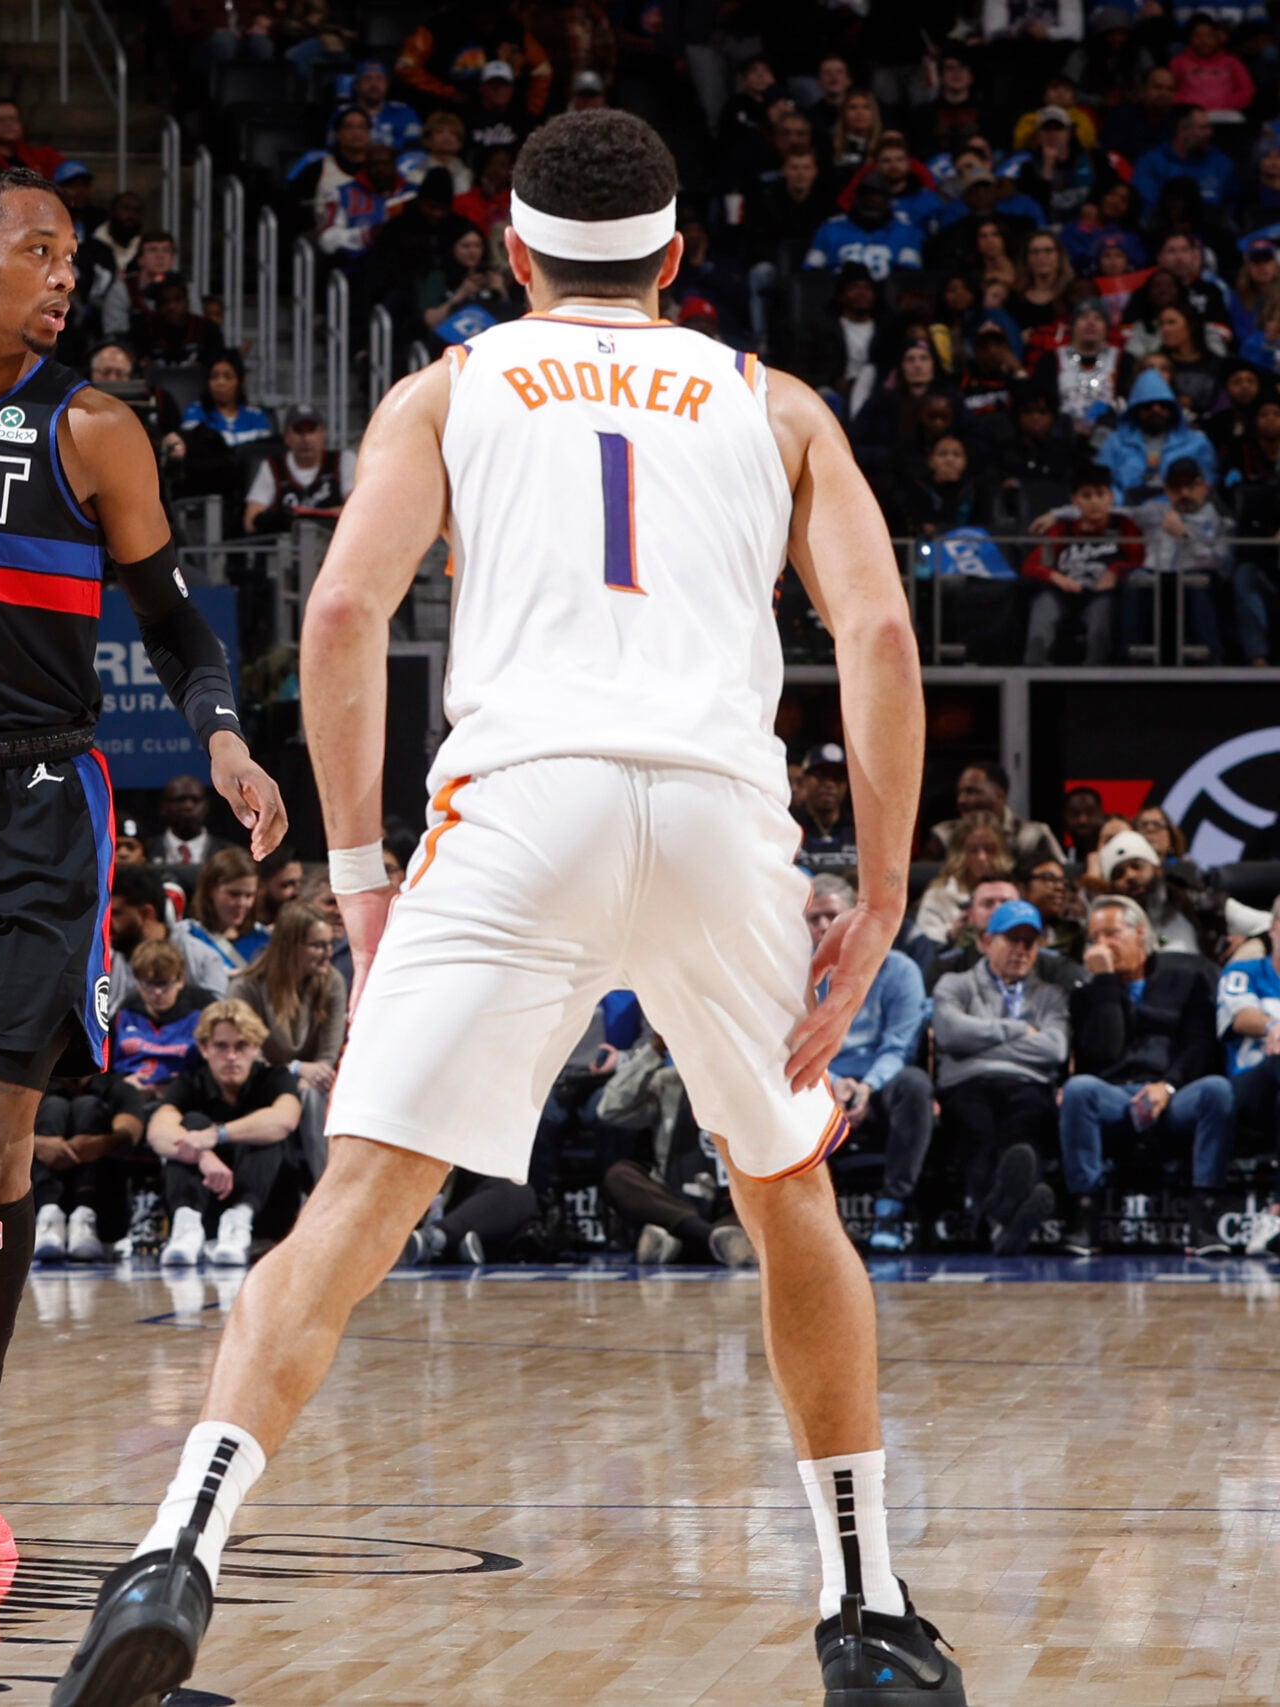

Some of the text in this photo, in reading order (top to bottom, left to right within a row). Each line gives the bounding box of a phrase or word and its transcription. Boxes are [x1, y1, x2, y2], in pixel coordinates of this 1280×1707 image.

[502, 359, 712, 422] BOOKER
[594, 430, 649, 596] 1
[141, 737, 192, 753] CLUB
